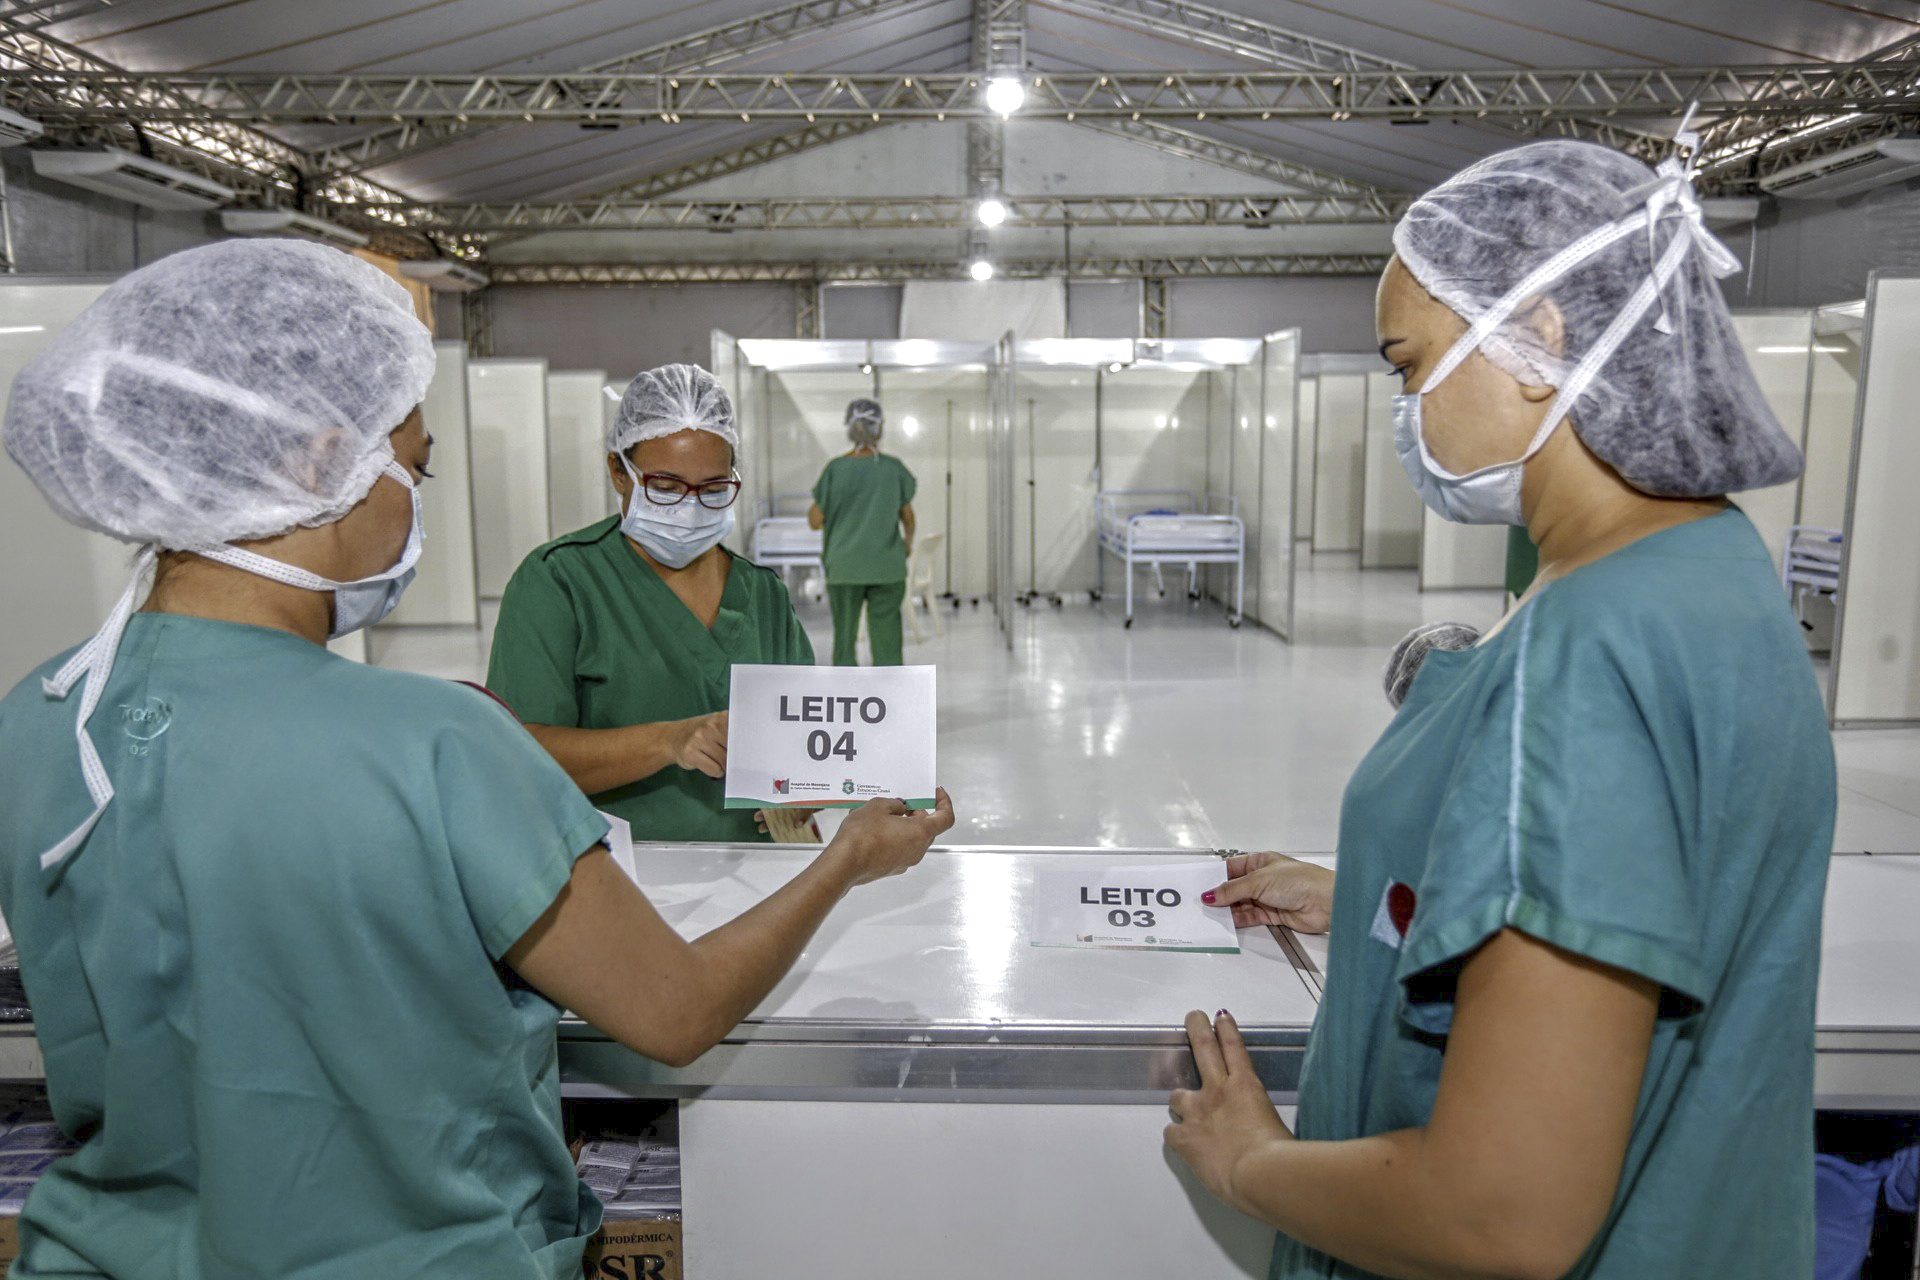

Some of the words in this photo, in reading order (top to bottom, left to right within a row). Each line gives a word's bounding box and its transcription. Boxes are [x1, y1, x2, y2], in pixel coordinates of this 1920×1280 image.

[779, 695, 887, 724] LEITO
[806, 729, 857, 762] 04
[1080, 886, 1182, 908] LEITO
[1107, 909, 1157, 928] 03
